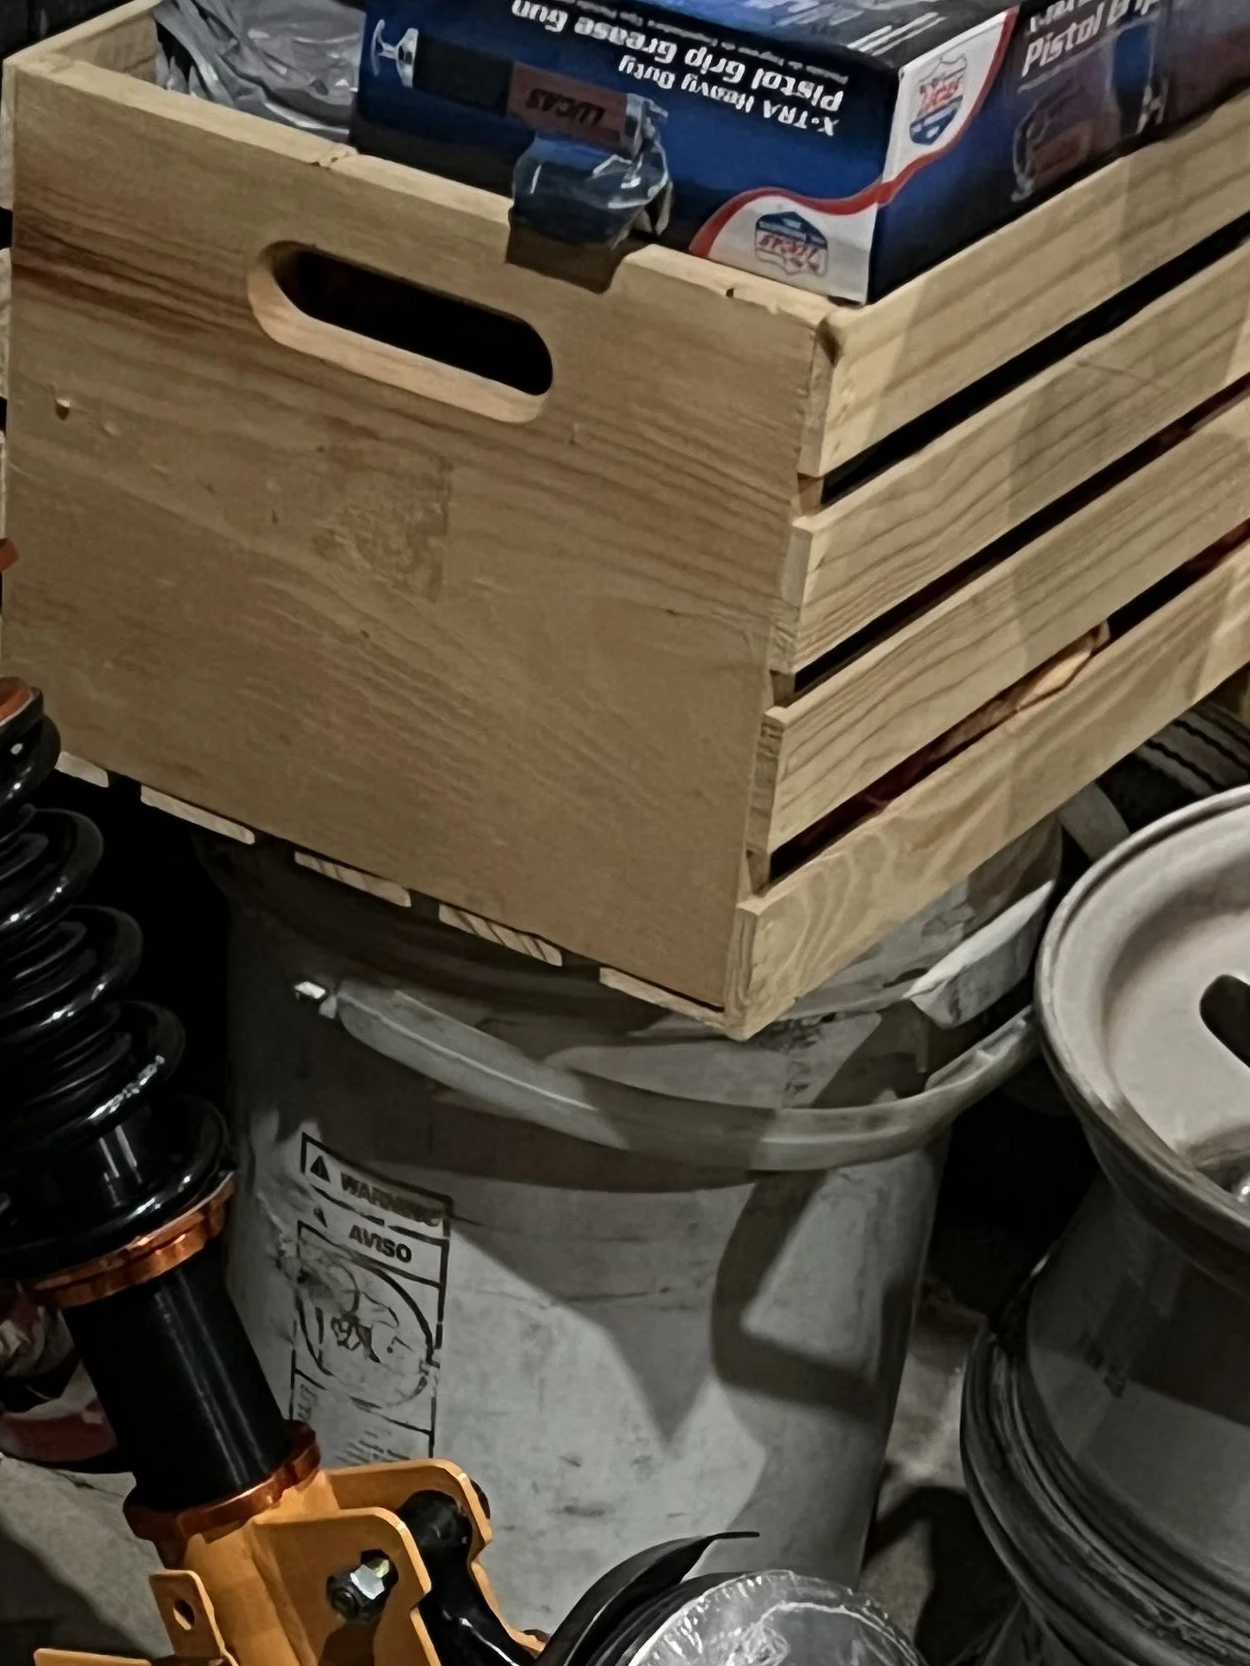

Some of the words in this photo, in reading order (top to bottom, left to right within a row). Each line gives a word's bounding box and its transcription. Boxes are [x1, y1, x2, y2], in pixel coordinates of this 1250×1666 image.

[511, 0, 569, 33] Gun
[574, 16, 678, 64] Grease
[1021, 2, 1105, 78] Pistol
[618, 55, 676, 90] Duty
[684, 47, 746, 84] Grip
[525, 88, 606, 129] LUCAS
[681, 73, 755, 113] Heavy
[750, 67, 844, 112] Pistol
[348, 1224, 413, 1264] AVISO
